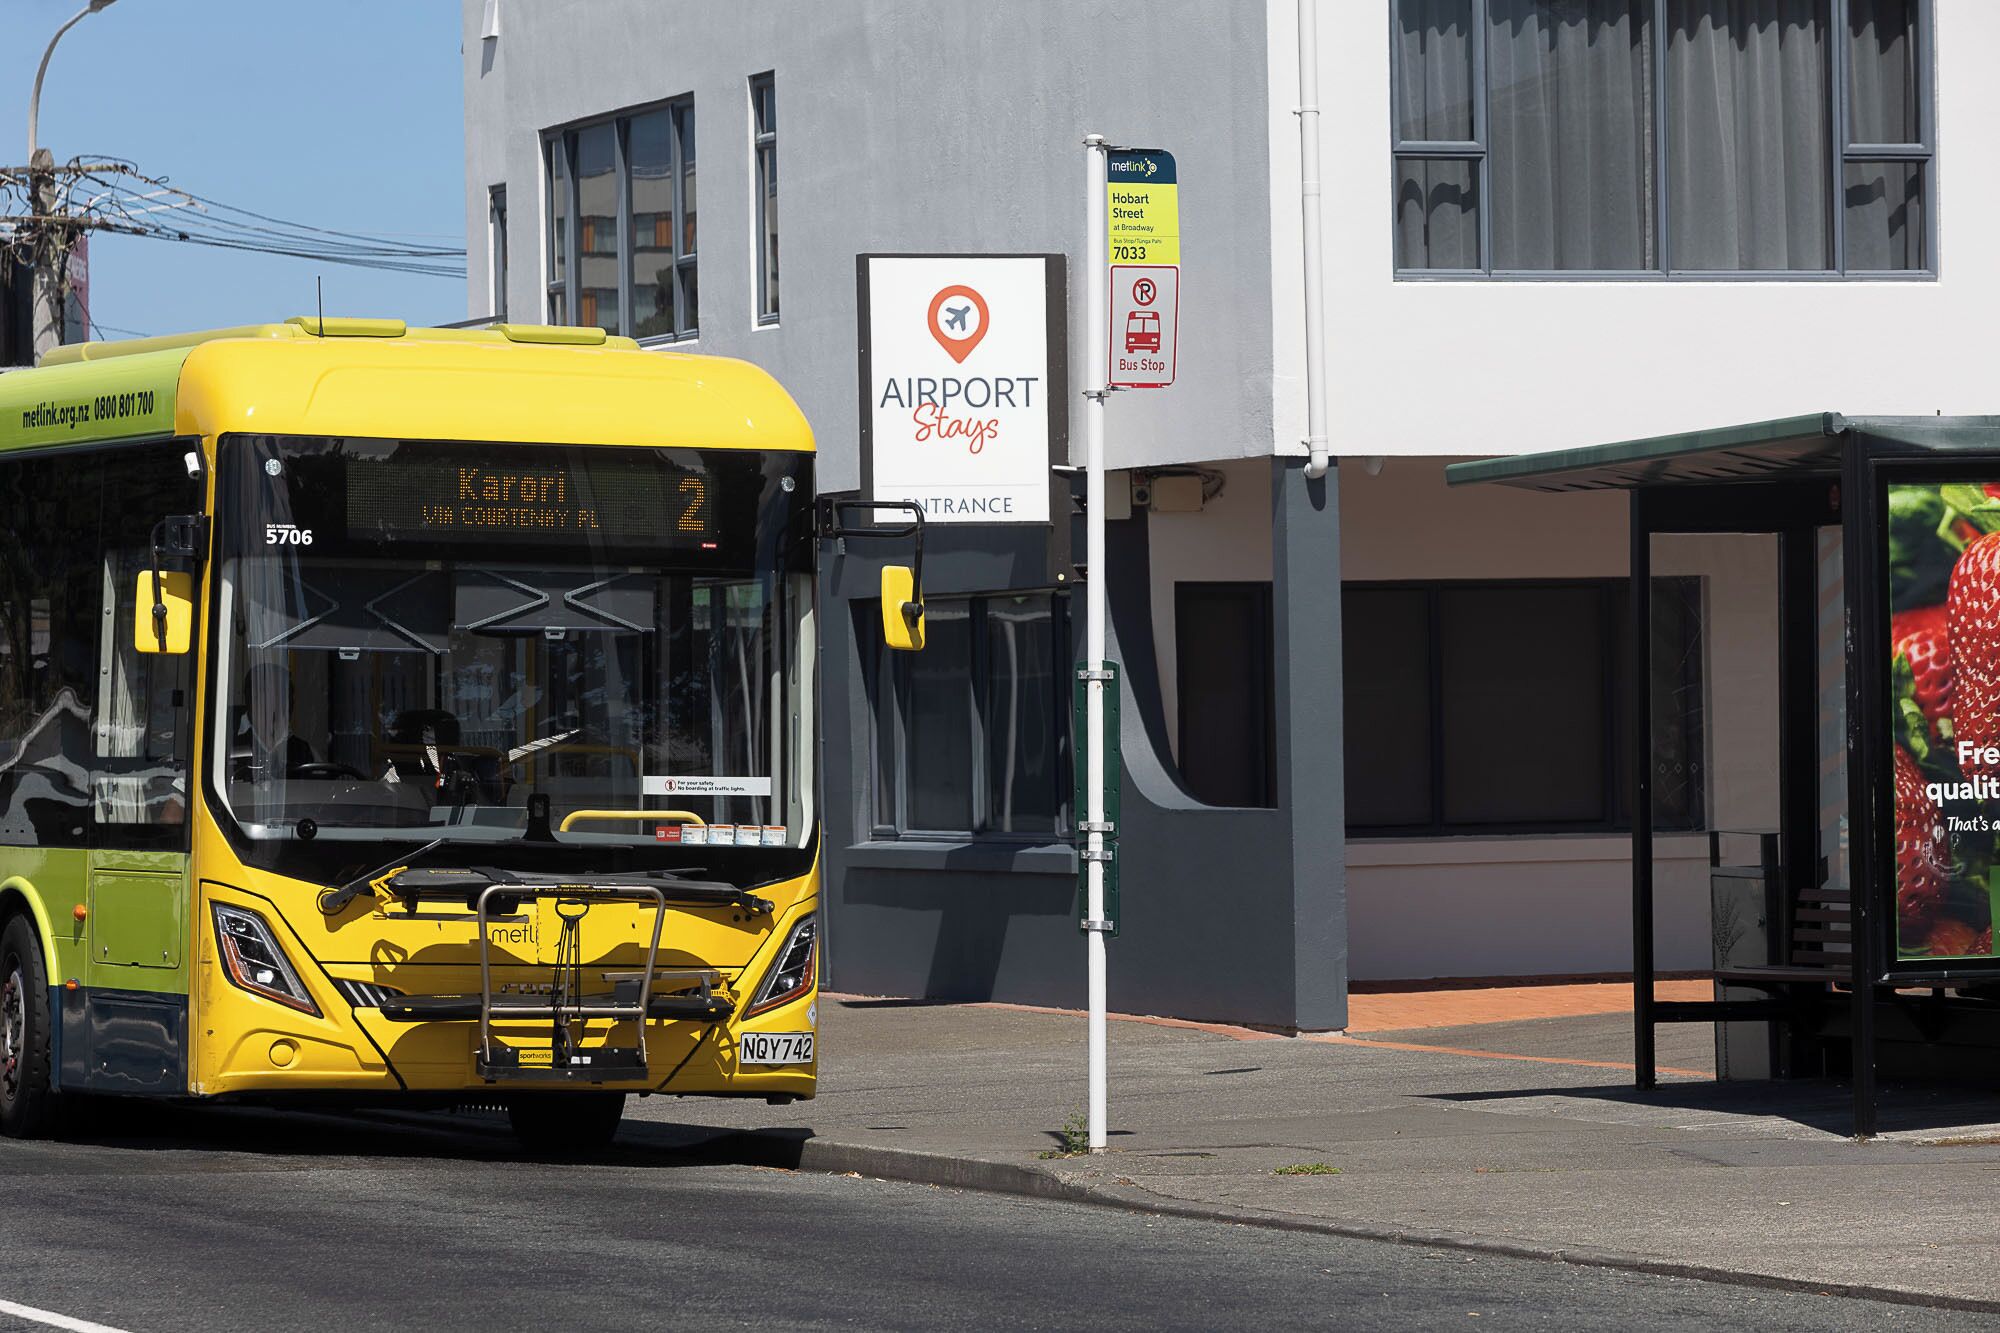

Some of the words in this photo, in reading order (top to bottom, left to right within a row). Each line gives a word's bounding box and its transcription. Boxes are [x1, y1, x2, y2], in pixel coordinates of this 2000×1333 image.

[1111, 161, 1146, 172] metlink
[1112, 193, 1149, 204] Hobart
[1112, 208, 1144, 219] Street
[1121, 224, 1154, 232] Broadway
[1113, 246, 1146, 260] 7033
[1119, 359, 1138, 371] Bus
[1141, 359, 1165, 373] Stop
[880, 377, 1039, 408] AIRPORT
[23, 401, 90, 430] metlink.org.nz
[94, 394, 117, 421] 0800
[119, 392, 136, 418] 801
[137, 390, 154, 415] 700
[913, 402, 999, 454] Stays
[459, 467, 565, 503] Karori
[678, 477, 704, 532] 2
[903, 497, 1013, 514] ENTRANCE
[423, 505, 453, 525] VIA
[462, 506, 569, 528] COURTENAY
[578, 510, 599, 529] PL
[266, 529, 313, 545] 5706
[1958, 740, 2000, 765] Fre
[1926, 774, 2000, 807] qualit
[743, 1037, 813, 1060] NQY742
